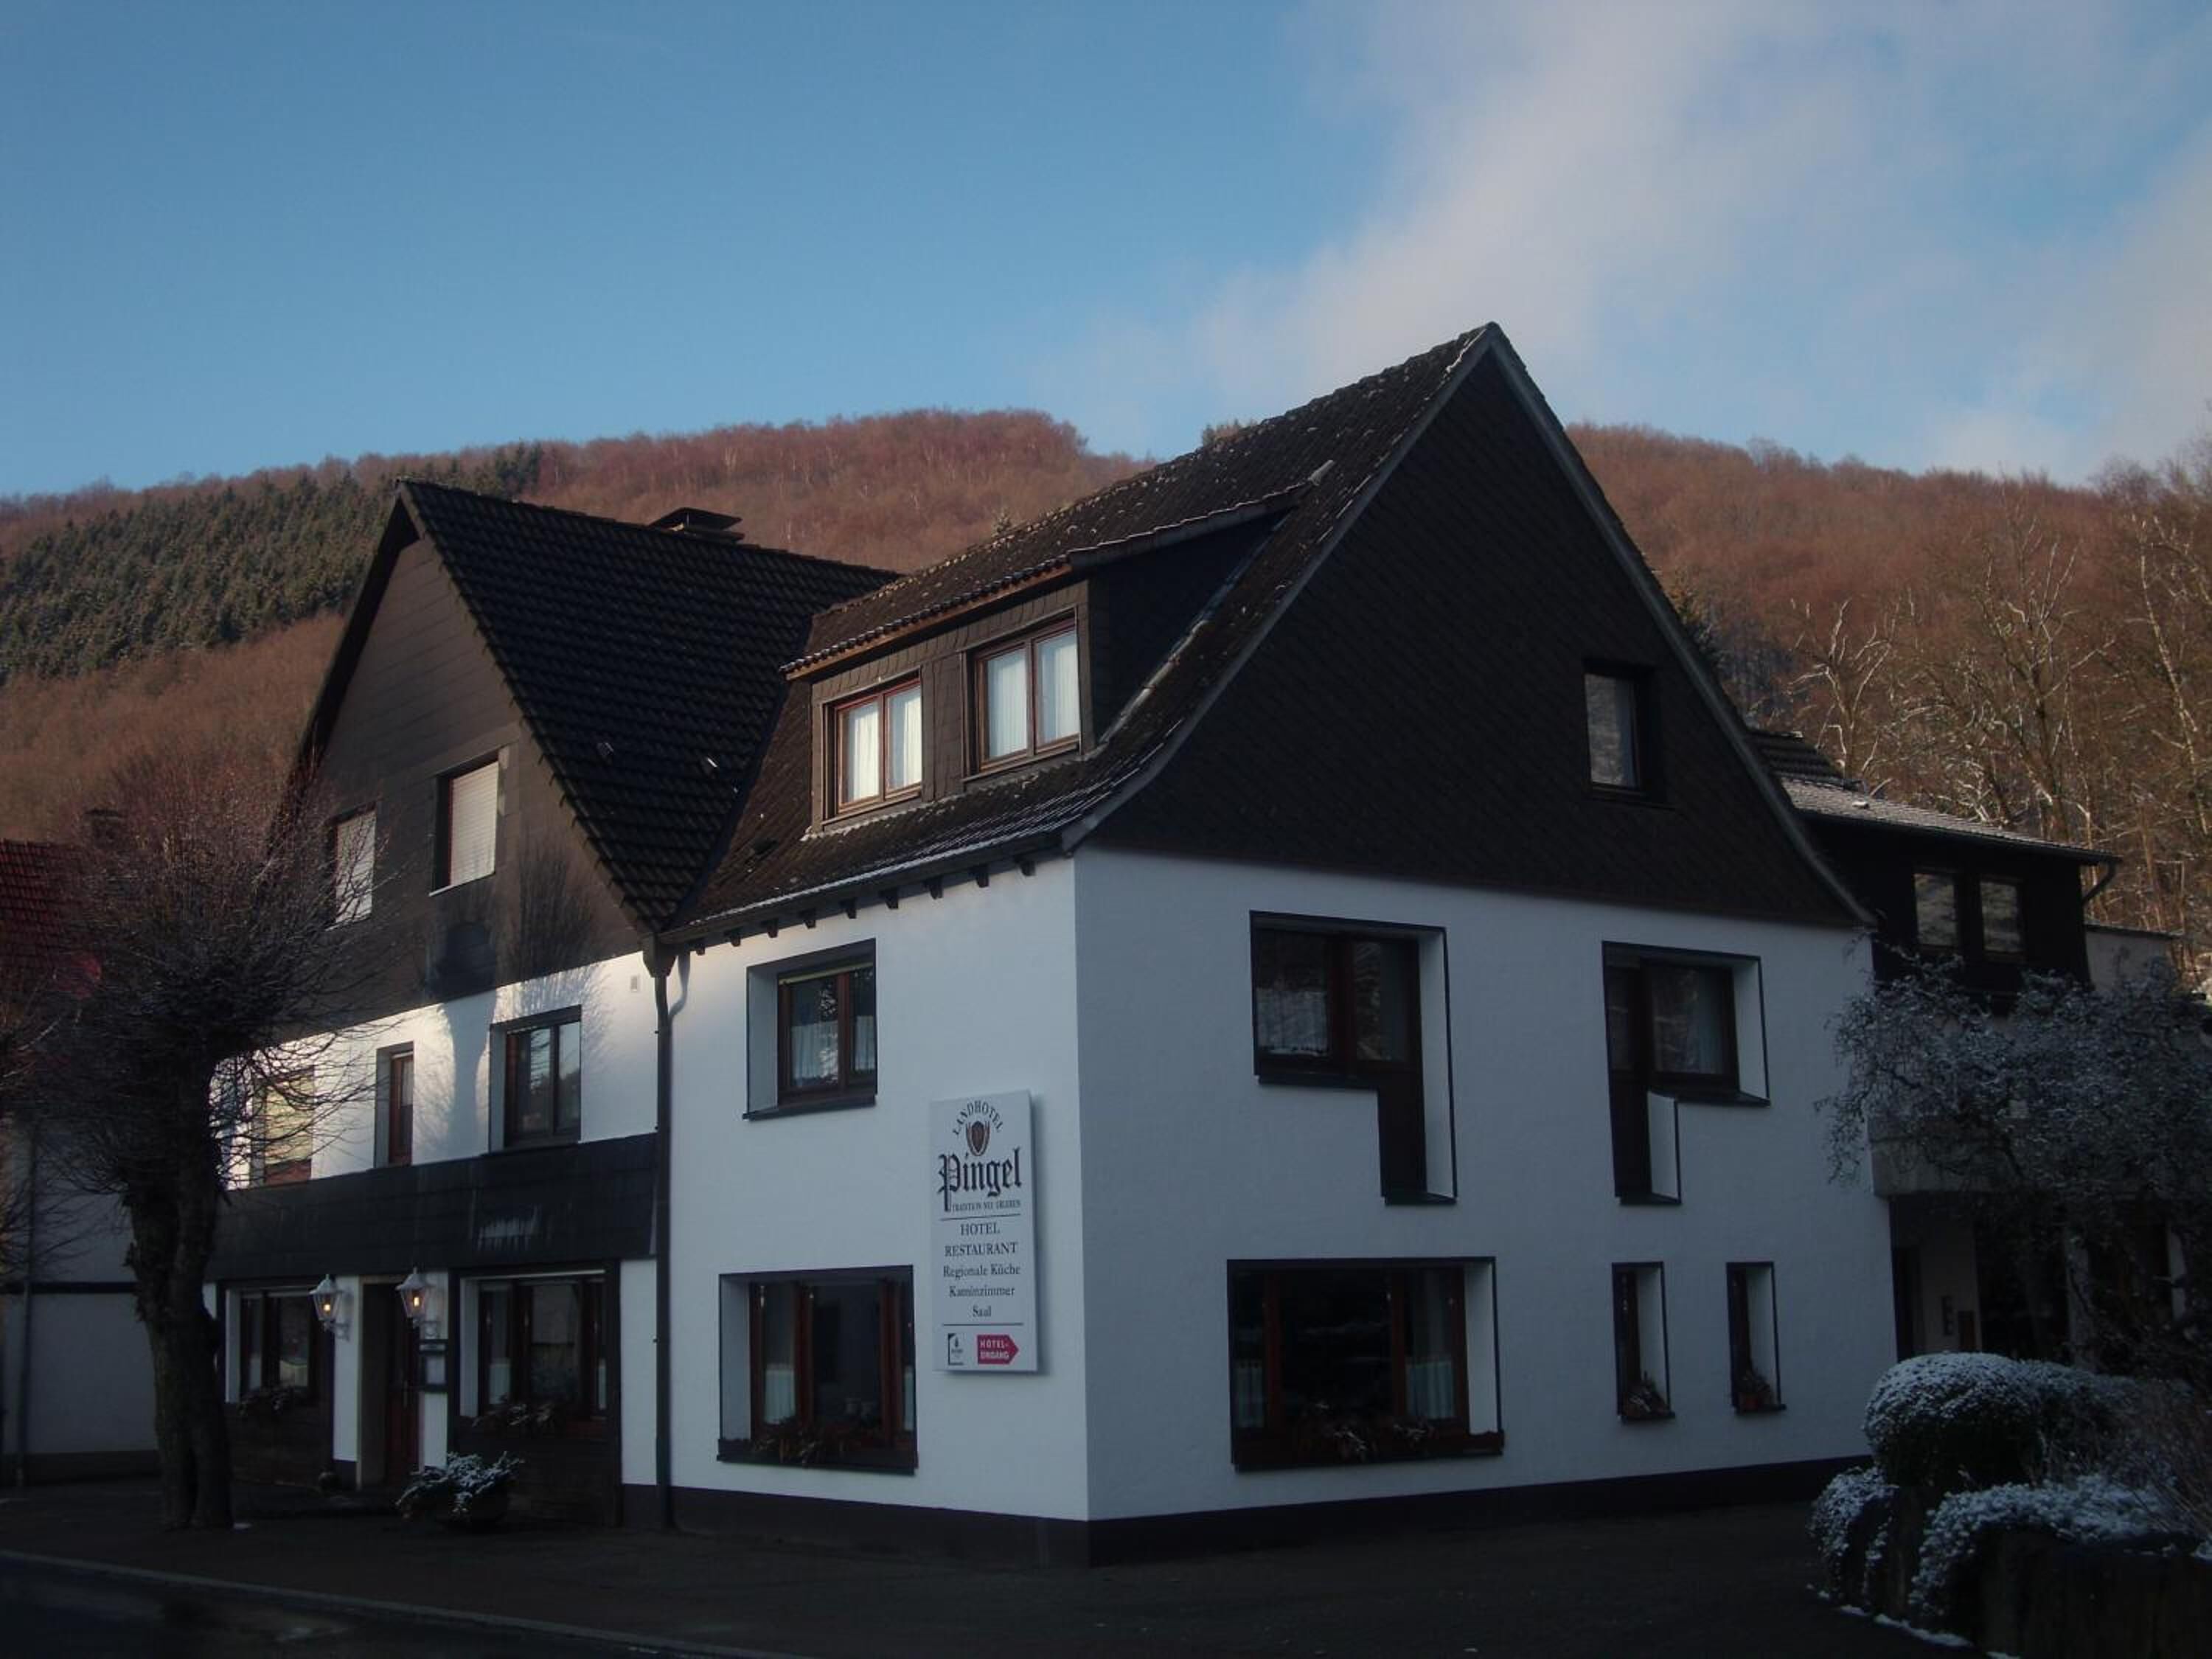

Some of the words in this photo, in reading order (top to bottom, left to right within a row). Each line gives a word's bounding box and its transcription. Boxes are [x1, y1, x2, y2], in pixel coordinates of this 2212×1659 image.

[953, 1101, 1003, 1135] LANDHOTEL
[937, 1147, 1021, 1211] Pingel
[960, 1222, 1001, 1236] HOTEL
[944, 1242, 1018, 1256] RESTAURANT
[943, 1265, 987, 1280] Regionale
[990, 1263, 1020, 1275] Küche
[949, 1285, 1015, 1297] Kaminzimmer
[973, 1305, 992, 1317] Saal
